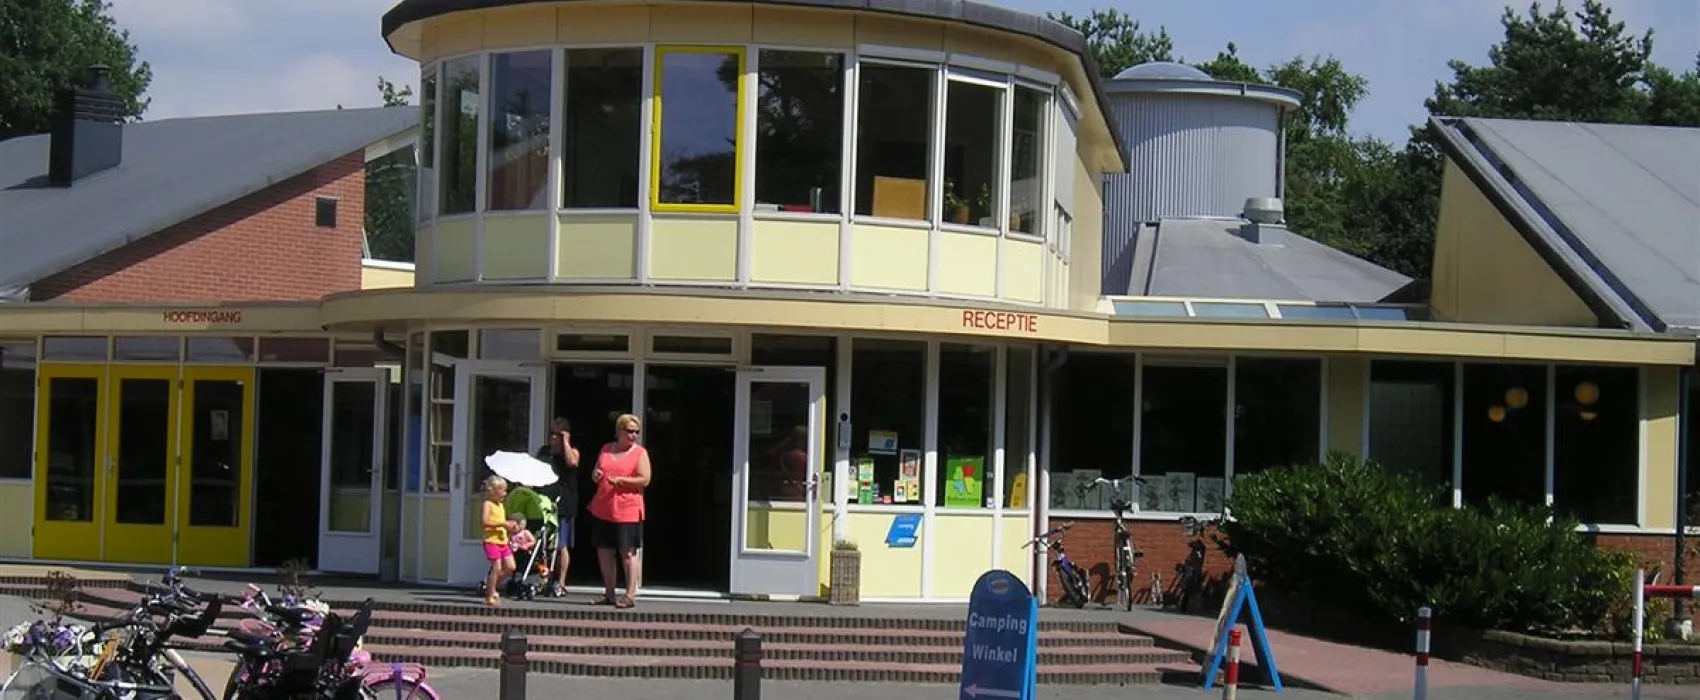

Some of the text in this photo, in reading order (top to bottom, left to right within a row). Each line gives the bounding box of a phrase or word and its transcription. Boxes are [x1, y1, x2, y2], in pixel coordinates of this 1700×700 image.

[162, 311, 241, 323] HOOFDINGANG
[962, 310, 1038, 332] RECEPTIE
[969, 612, 1027, 634] Camping
[972, 643, 1017, 662] Winkel
